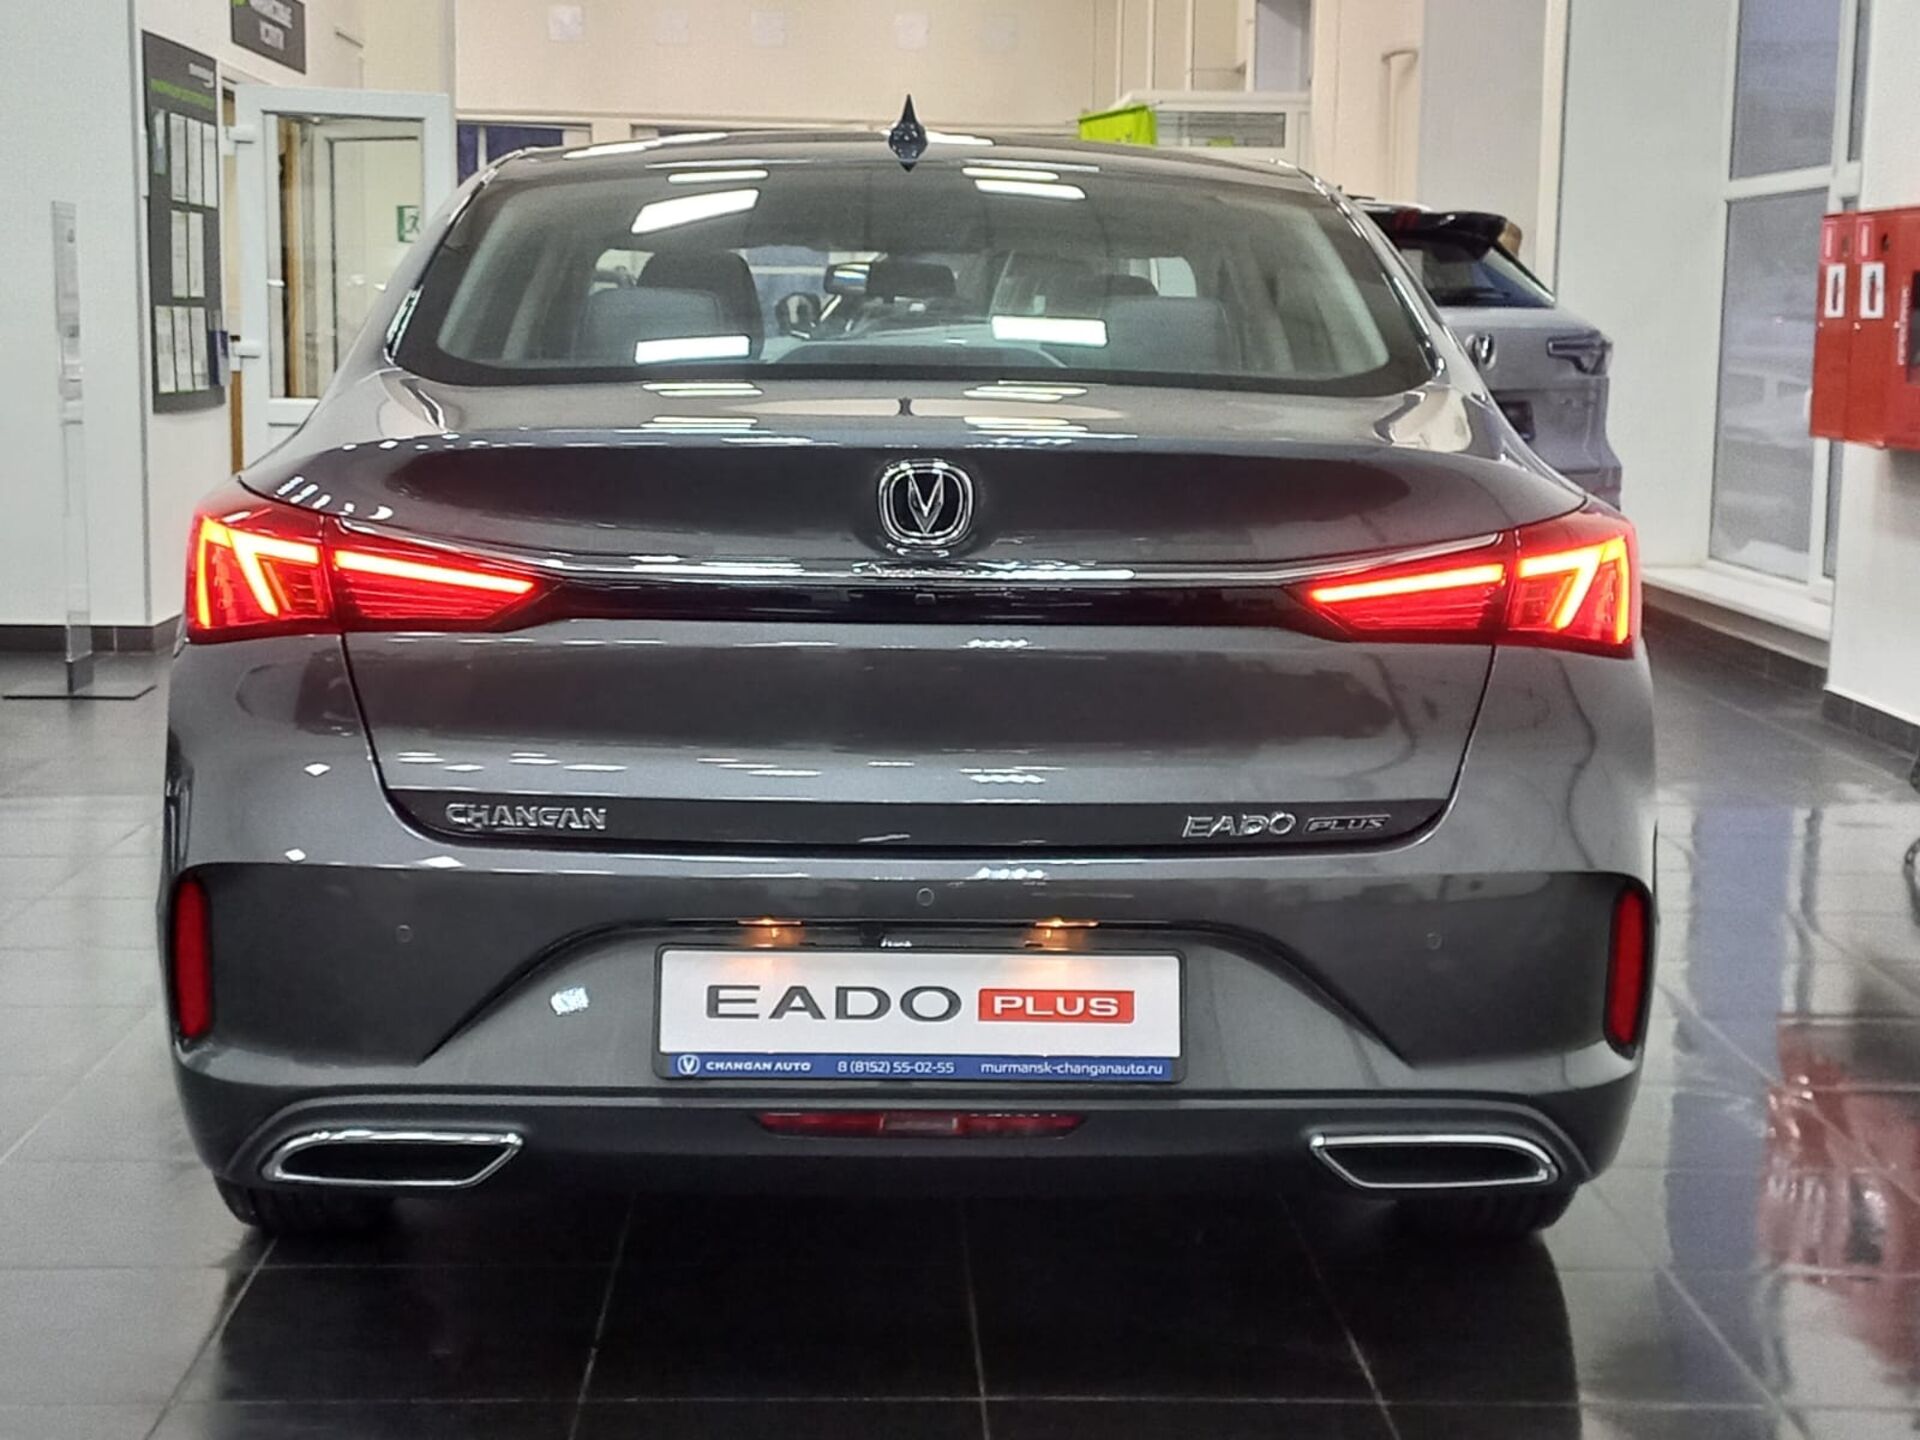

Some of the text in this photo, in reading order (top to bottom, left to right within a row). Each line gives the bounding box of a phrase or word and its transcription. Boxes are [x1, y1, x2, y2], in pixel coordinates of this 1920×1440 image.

[445, 803, 607, 830] CHANGAN
[1182, 812, 1386, 838] EADO PLUS
[706, 984, 1120, 1022] EADO PLUS
[705, 1060, 812, 1072] CHANGAN AUTO
[837, 1059, 955, 1075] 8 (8152) 55-02-55
[980, 1060, 1163, 1077] murmansk-changanauto.ru
